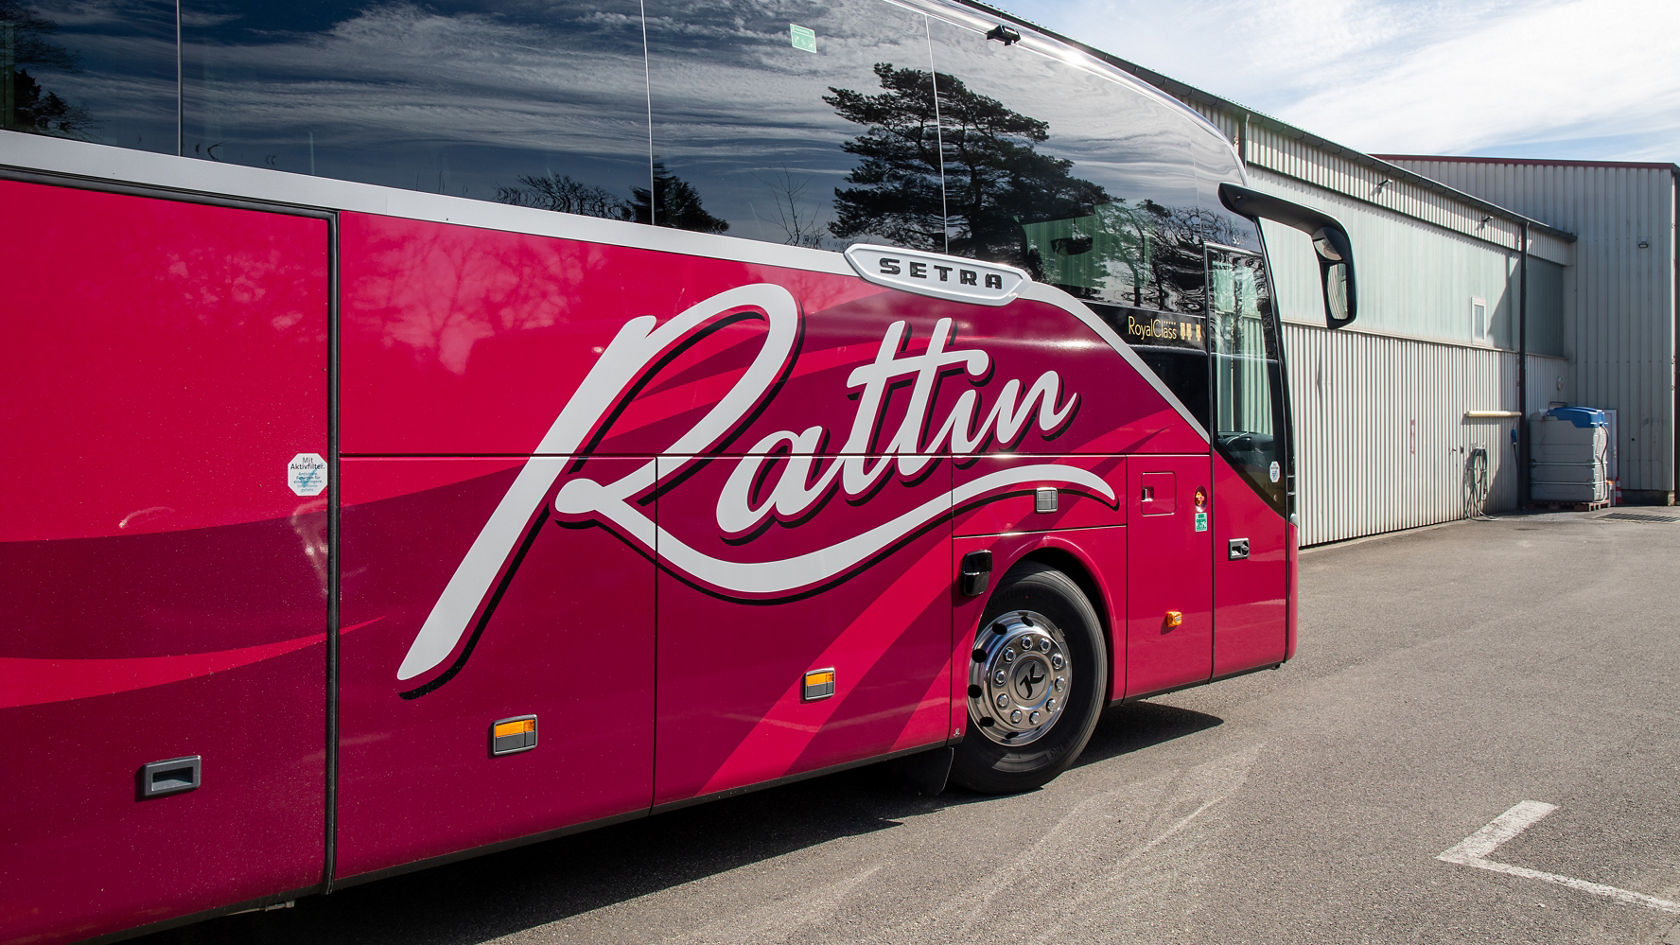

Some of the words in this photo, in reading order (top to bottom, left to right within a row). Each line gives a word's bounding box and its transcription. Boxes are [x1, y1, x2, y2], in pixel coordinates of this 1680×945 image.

[879, 257, 1003, 290] SETRA
[1128, 315, 1177, 340] RoyalClass
[397, 283, 1117, 683] Rattin
